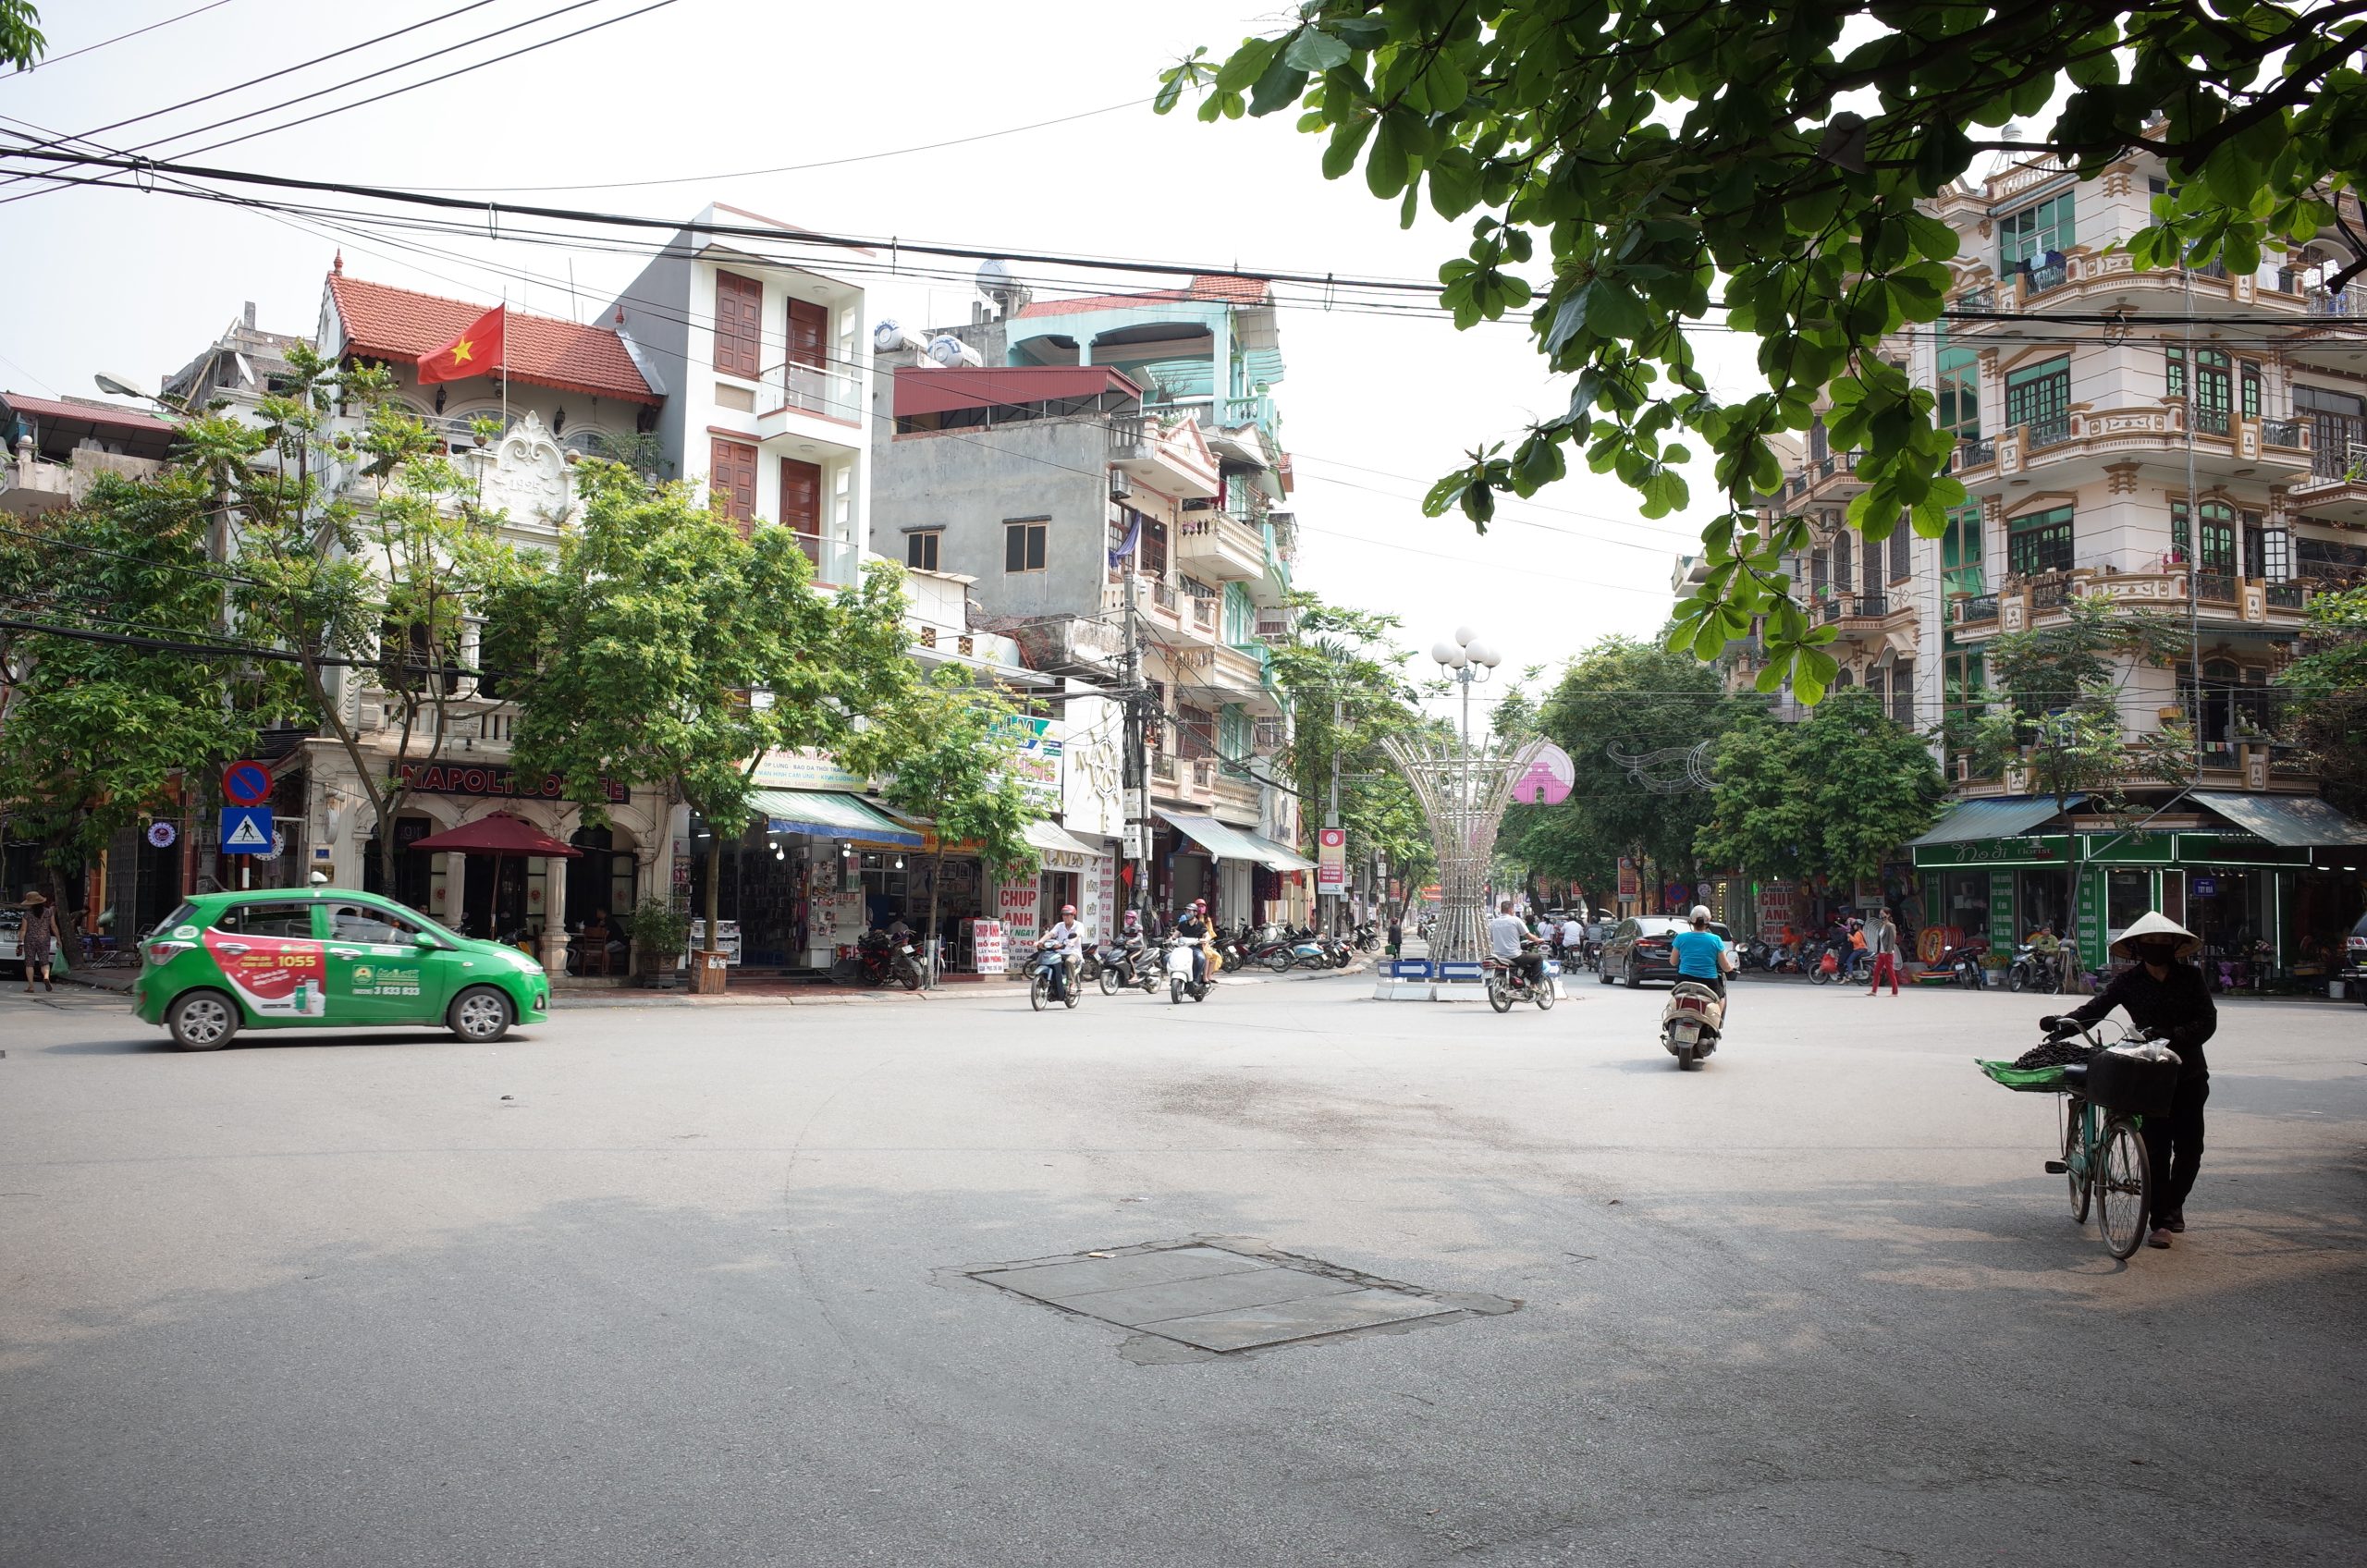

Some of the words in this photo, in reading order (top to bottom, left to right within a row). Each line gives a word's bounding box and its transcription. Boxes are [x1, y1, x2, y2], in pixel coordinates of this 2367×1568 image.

[400, 765, 514, 794] NAPOLI
[1000, 889, 1037, 911] CHỤP
[1003, 909, 1035, 926] ẢNH
[278, 955, 316, 967] 1055
[374, 986, 381, 995] 3
